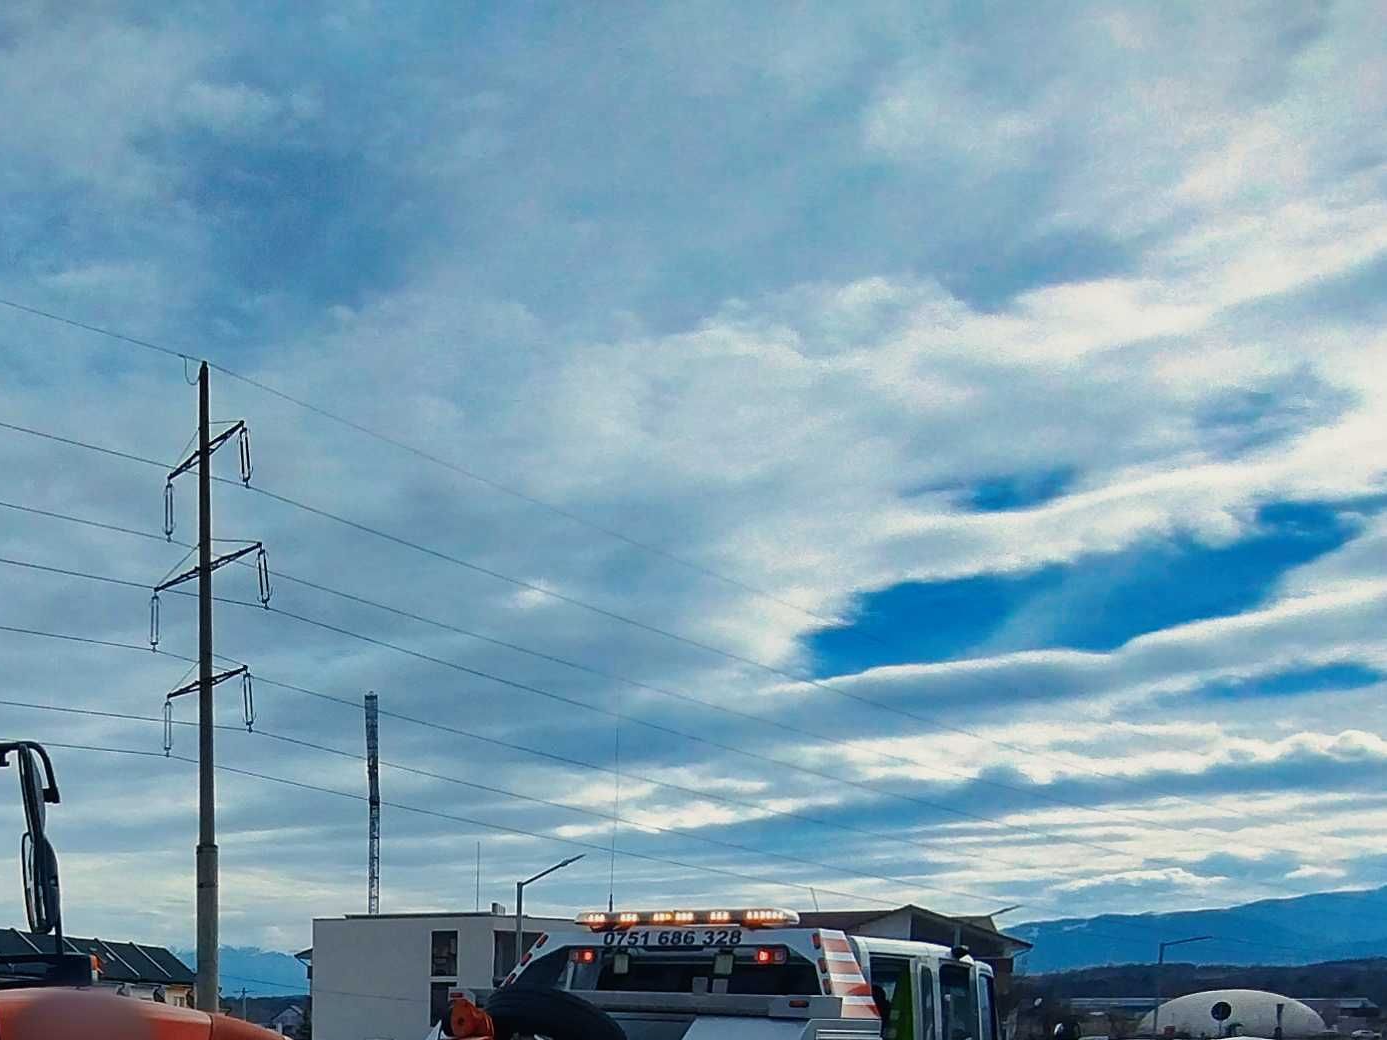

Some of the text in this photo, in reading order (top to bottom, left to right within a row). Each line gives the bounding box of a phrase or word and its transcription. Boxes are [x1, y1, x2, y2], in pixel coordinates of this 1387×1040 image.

[604, 930, 742, 946] 0751 686 328
